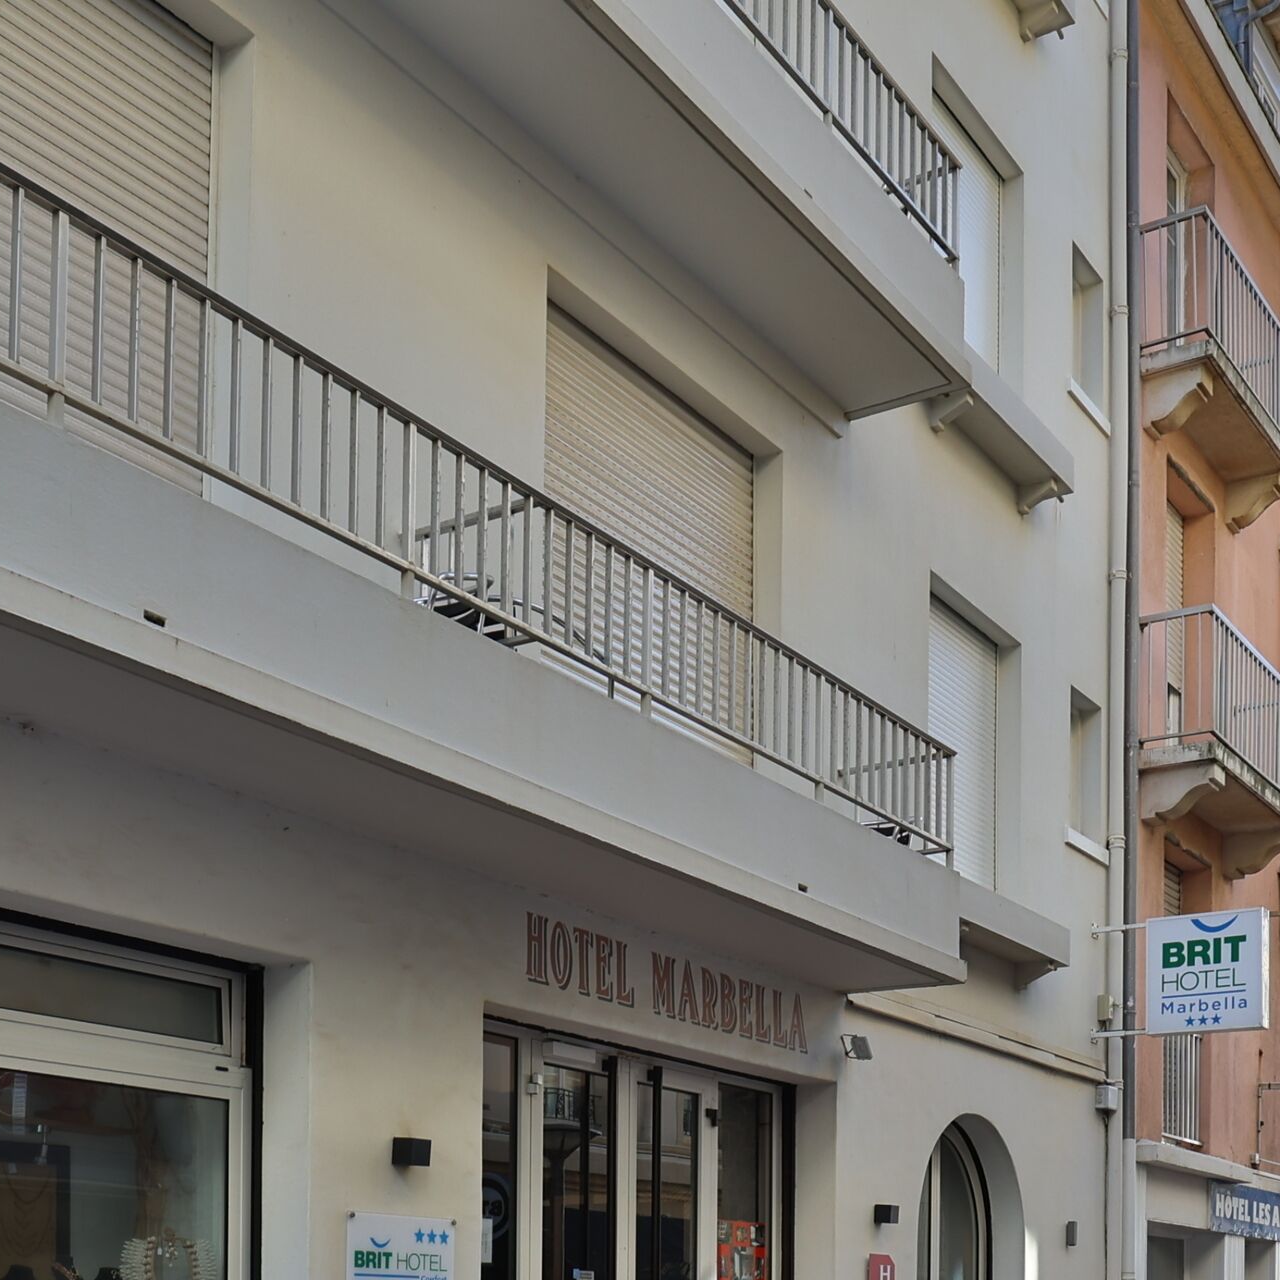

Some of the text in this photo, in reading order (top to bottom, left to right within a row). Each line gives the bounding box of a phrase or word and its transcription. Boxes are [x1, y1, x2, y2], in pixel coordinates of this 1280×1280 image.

[1162, 934, 1247, 969] BRIT
[526, 911, 809, 1054] HOTEL MARBELLA
[1162, 967, 1247, 993] HOTEL
[1161, 996, 1248, 1016] Marbella
[1215, 1190, 1251, 1222] HÔTEL
[1252, 1201, 1271, 1226] LES
[354, 1250, 448, 1272] BRIT HOTEL
